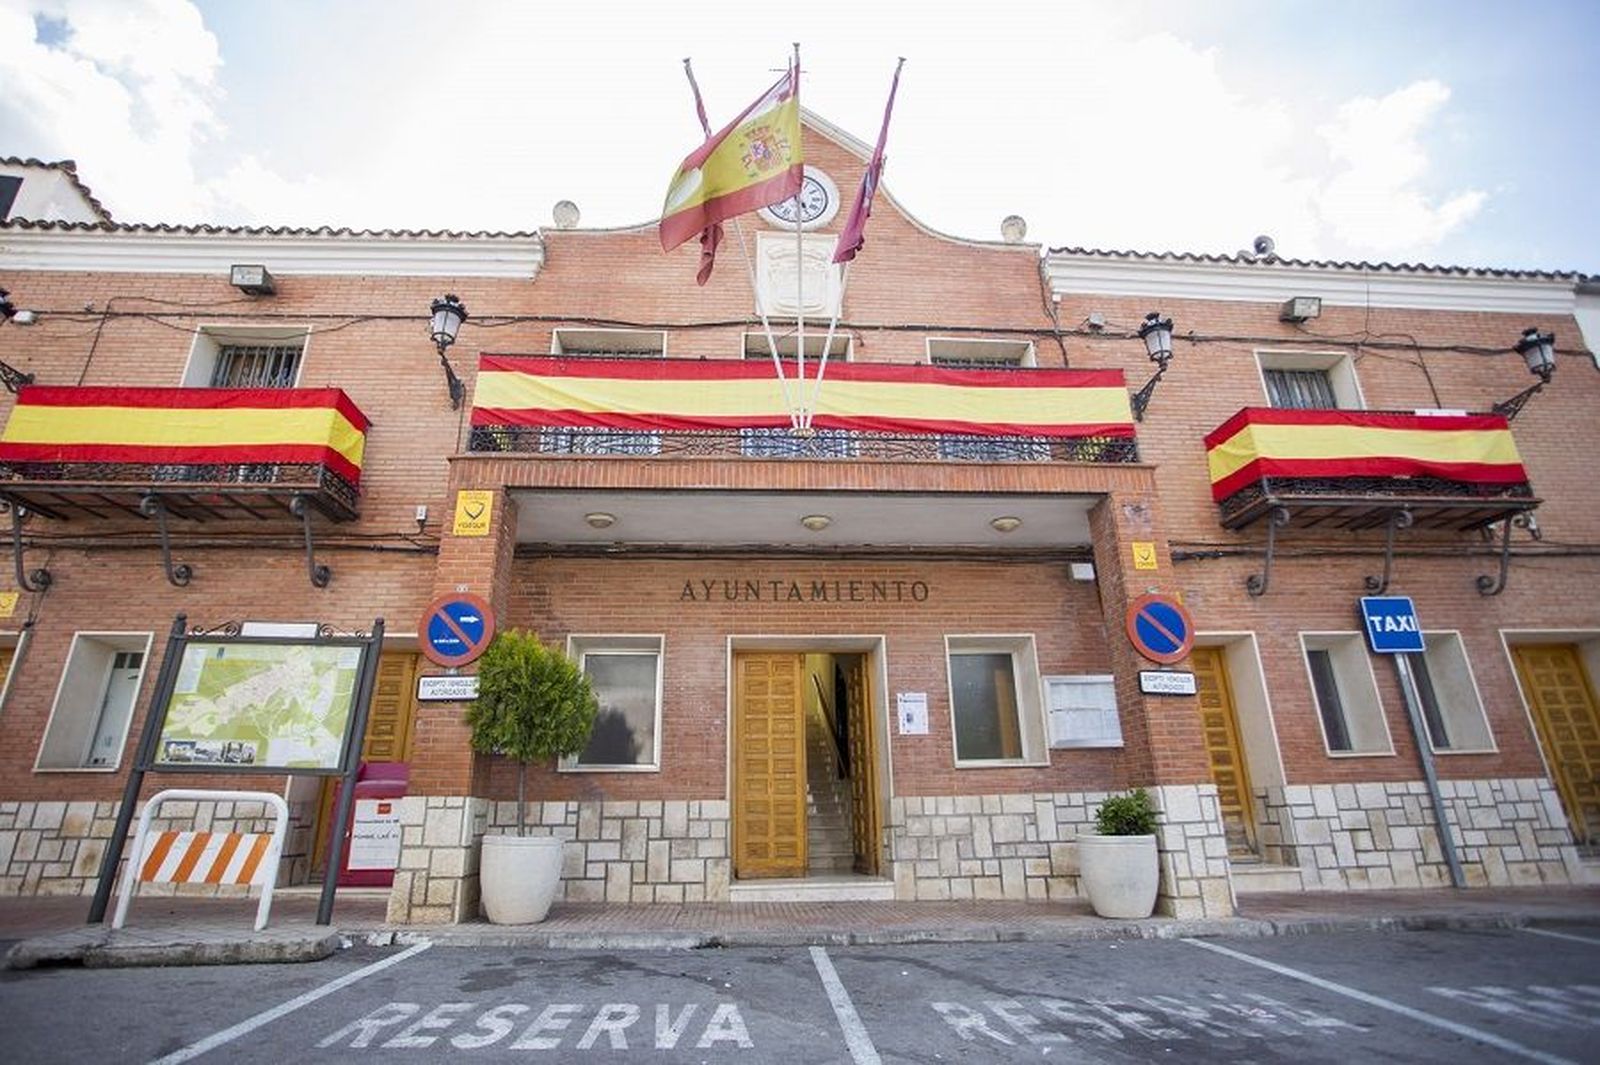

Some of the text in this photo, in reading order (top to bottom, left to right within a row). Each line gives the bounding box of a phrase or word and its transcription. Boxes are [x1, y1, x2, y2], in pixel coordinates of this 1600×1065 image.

[680, 579, 929, 601] AYUNTAMIENTO
[1369, 615, 1416, 632] TAXI
[314, 1002, 754, 1050] RESERVA
